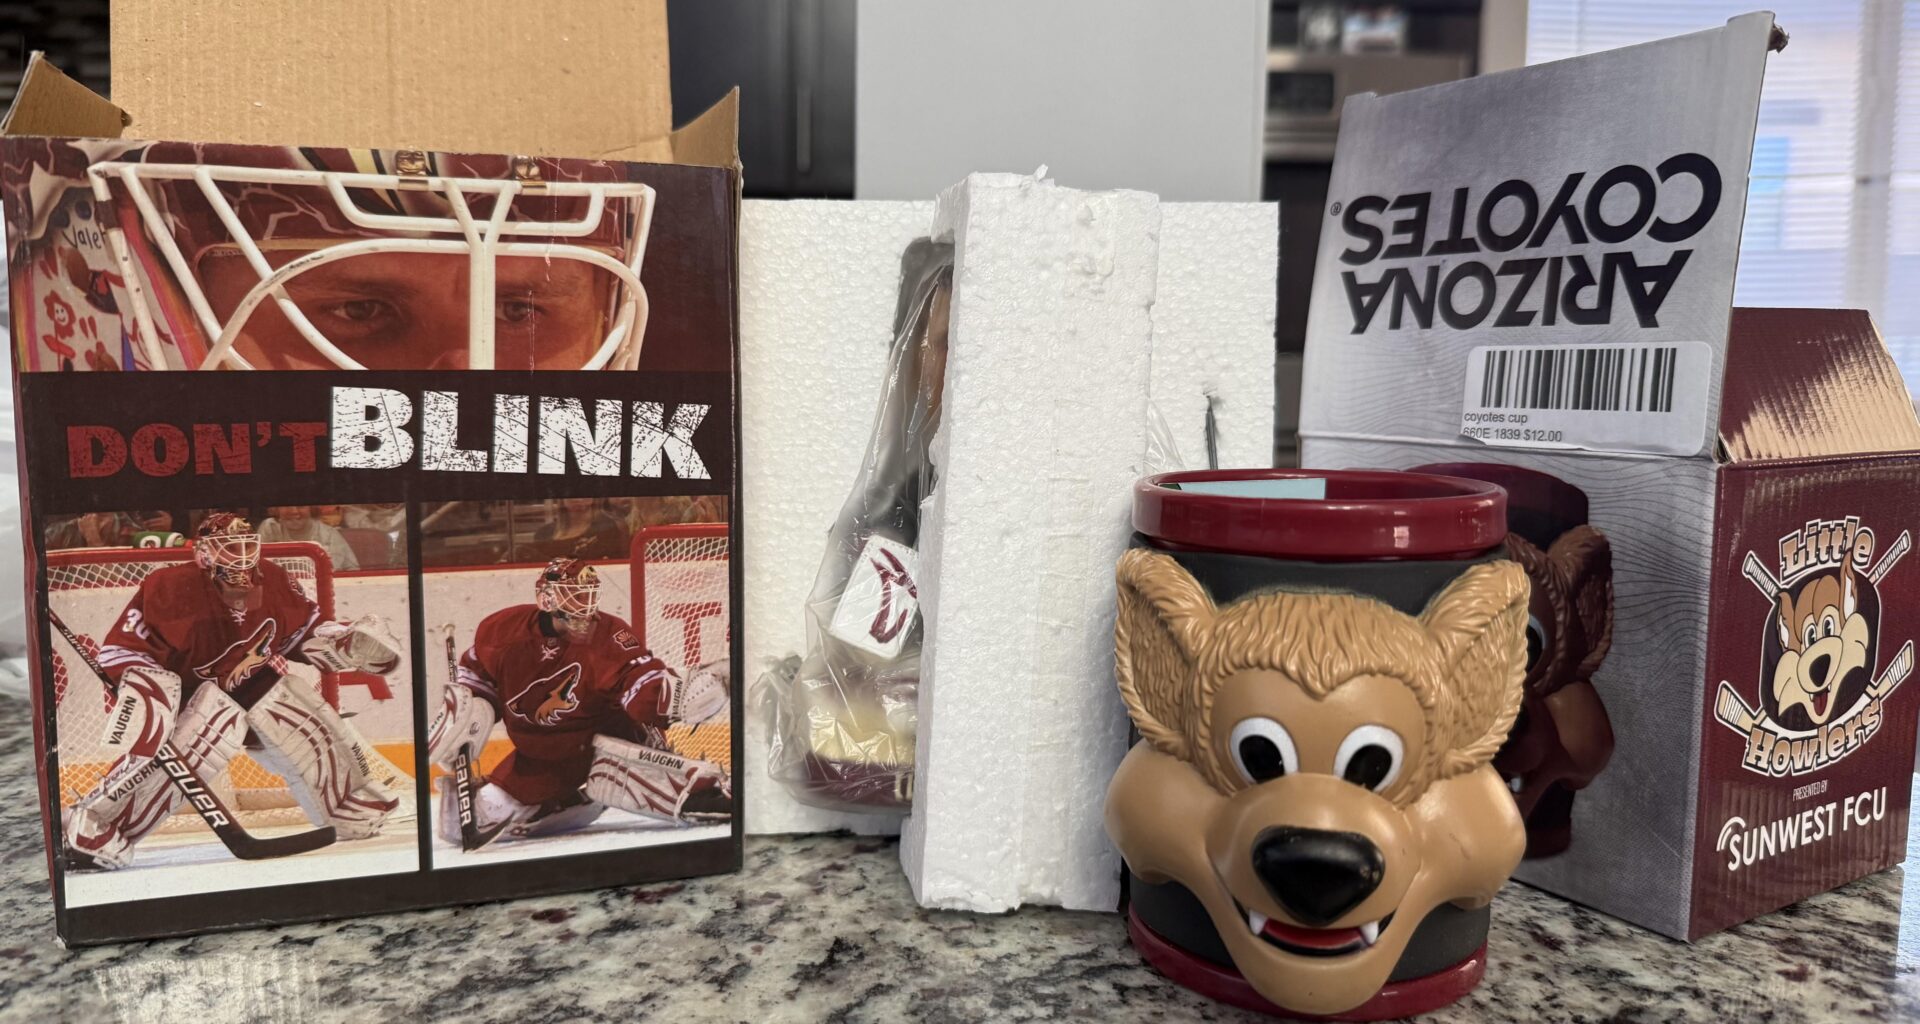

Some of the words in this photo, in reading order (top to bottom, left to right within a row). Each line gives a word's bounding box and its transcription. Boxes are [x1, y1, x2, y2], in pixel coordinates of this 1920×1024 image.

[1339, 152, 1723, 266] COYOTES
[1341, 249, 1693, 335] ARIZONA
[66, 421, 327, 478] DON'T
[331, 385, 712, 480] BLINK
[1463, 412, 1505, 425] coyotes
[1507, 414, 1528, 426] cup
[1494, 428, 1520, 440] 1839
[1523, 428, 1563, 442] $12.00
[1779, 516, 1874, 583] Little
[109, 695, 138, 745] VAUGHN
[672, 679, 684, 718] VAUGHN
[351, 742, 370, 777] VAUGHN
[638, 749, 685, 771] VAUGHN
[1743, 697, 1882, 776] Howlers
[107, 761, 160, 803] VAUGHN
[455, 753, 472, 827] BAUER
[1793, 783, 1820, 801] PRESENTED
[1821, 779, 1828, 793] BY
[1727, 802, 1837, 872] SUNWEST
[1843, 786, 1888, 832] FCU
